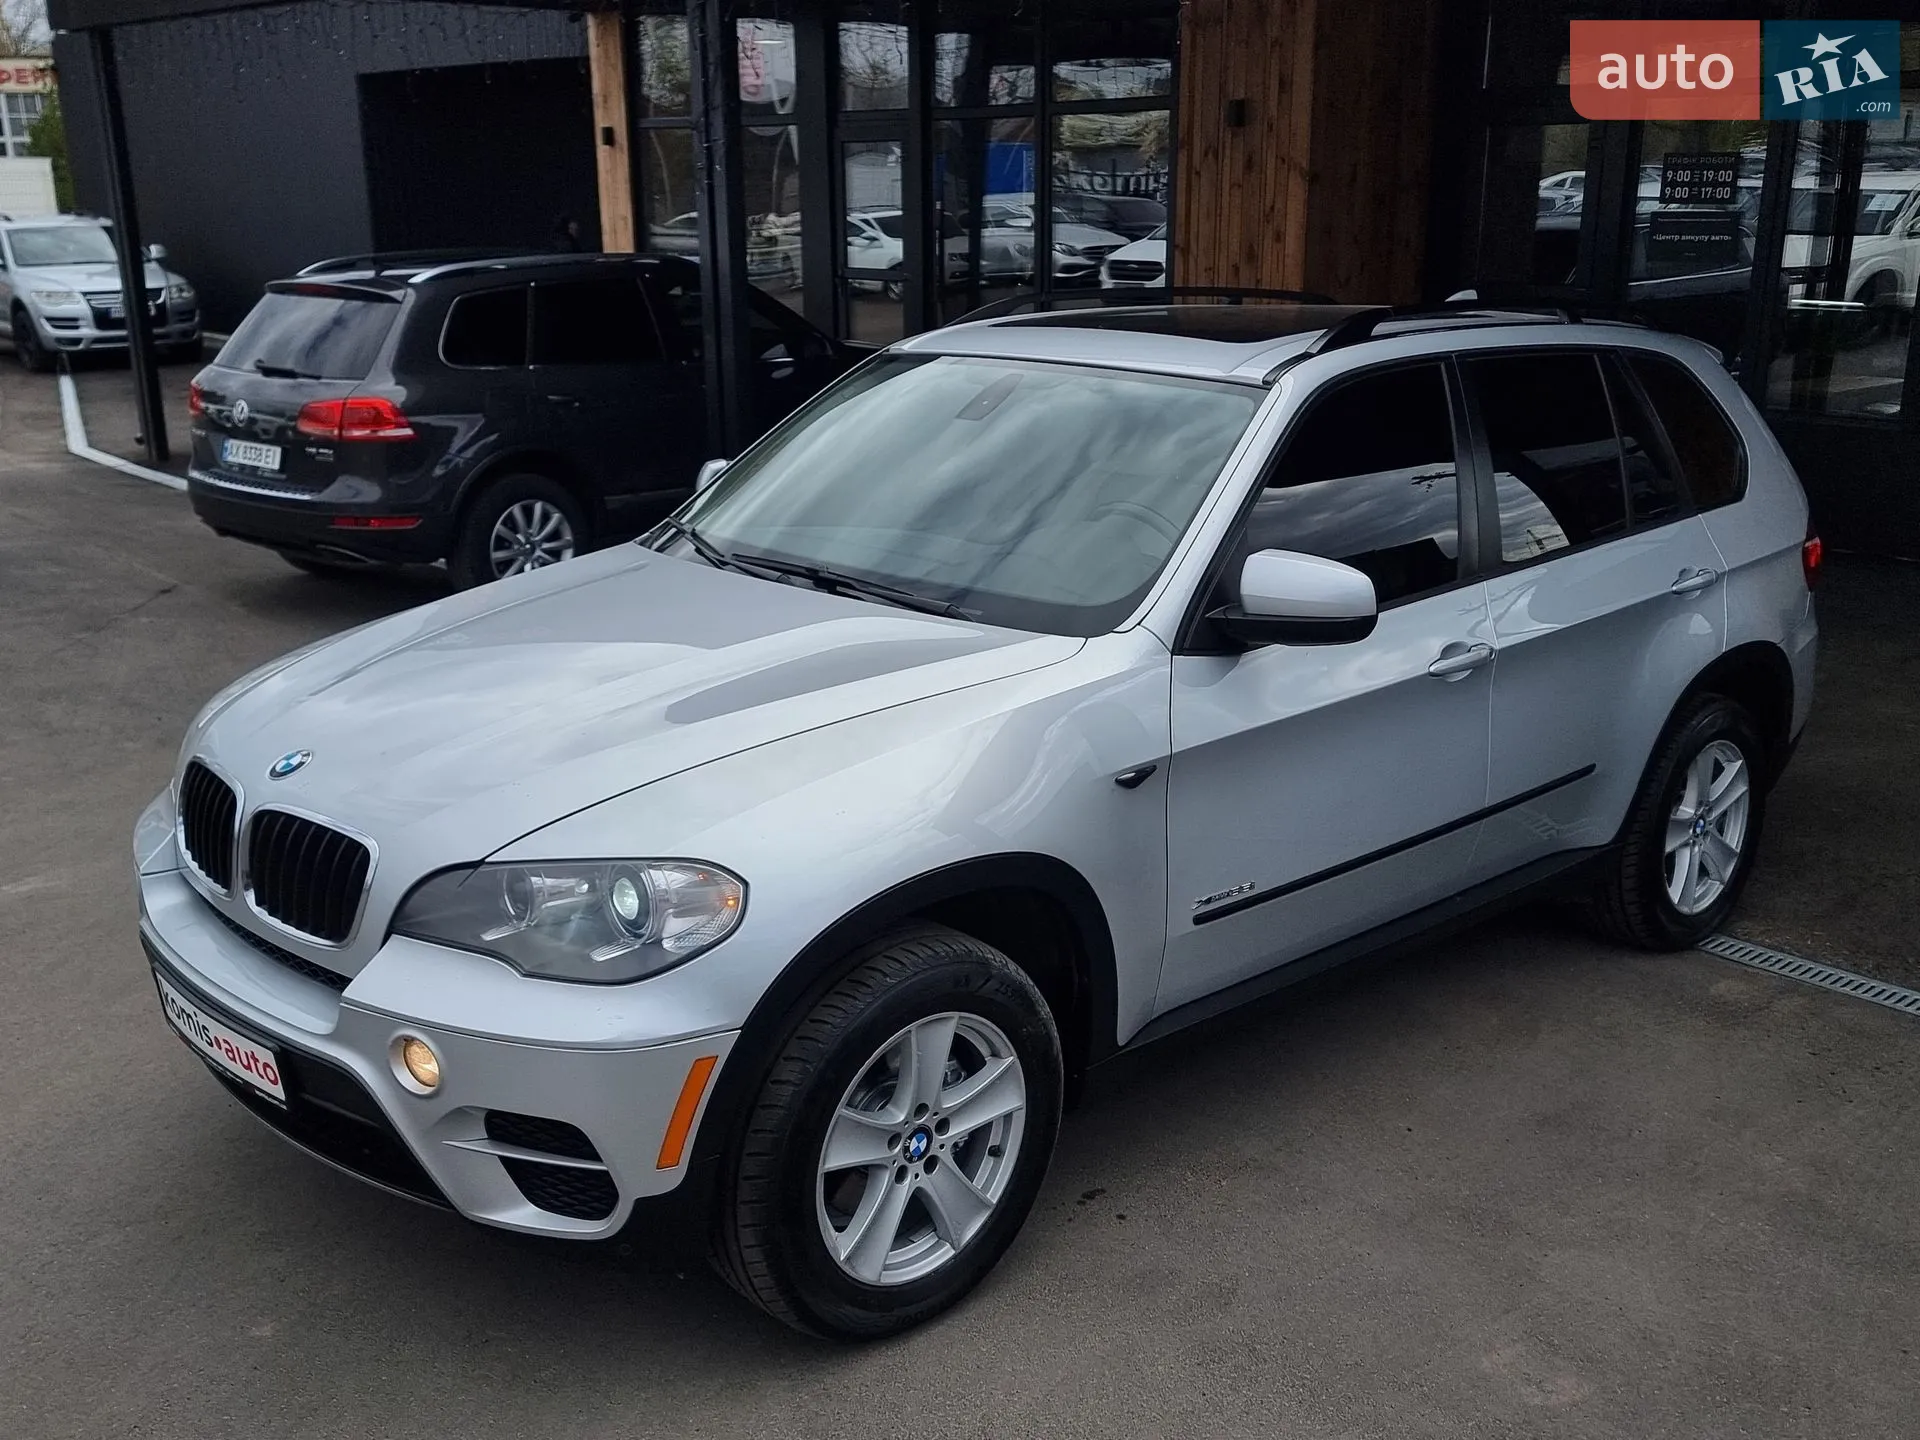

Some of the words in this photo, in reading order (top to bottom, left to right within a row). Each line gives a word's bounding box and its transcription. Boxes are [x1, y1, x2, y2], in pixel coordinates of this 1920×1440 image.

[1666, 170, 1691, 182] 9:00
[1702, 170, 1733, 182] 19:00
[1664, 186, 1689, 199] 9:00
[1700, 187, 1731, 199] 17:00
